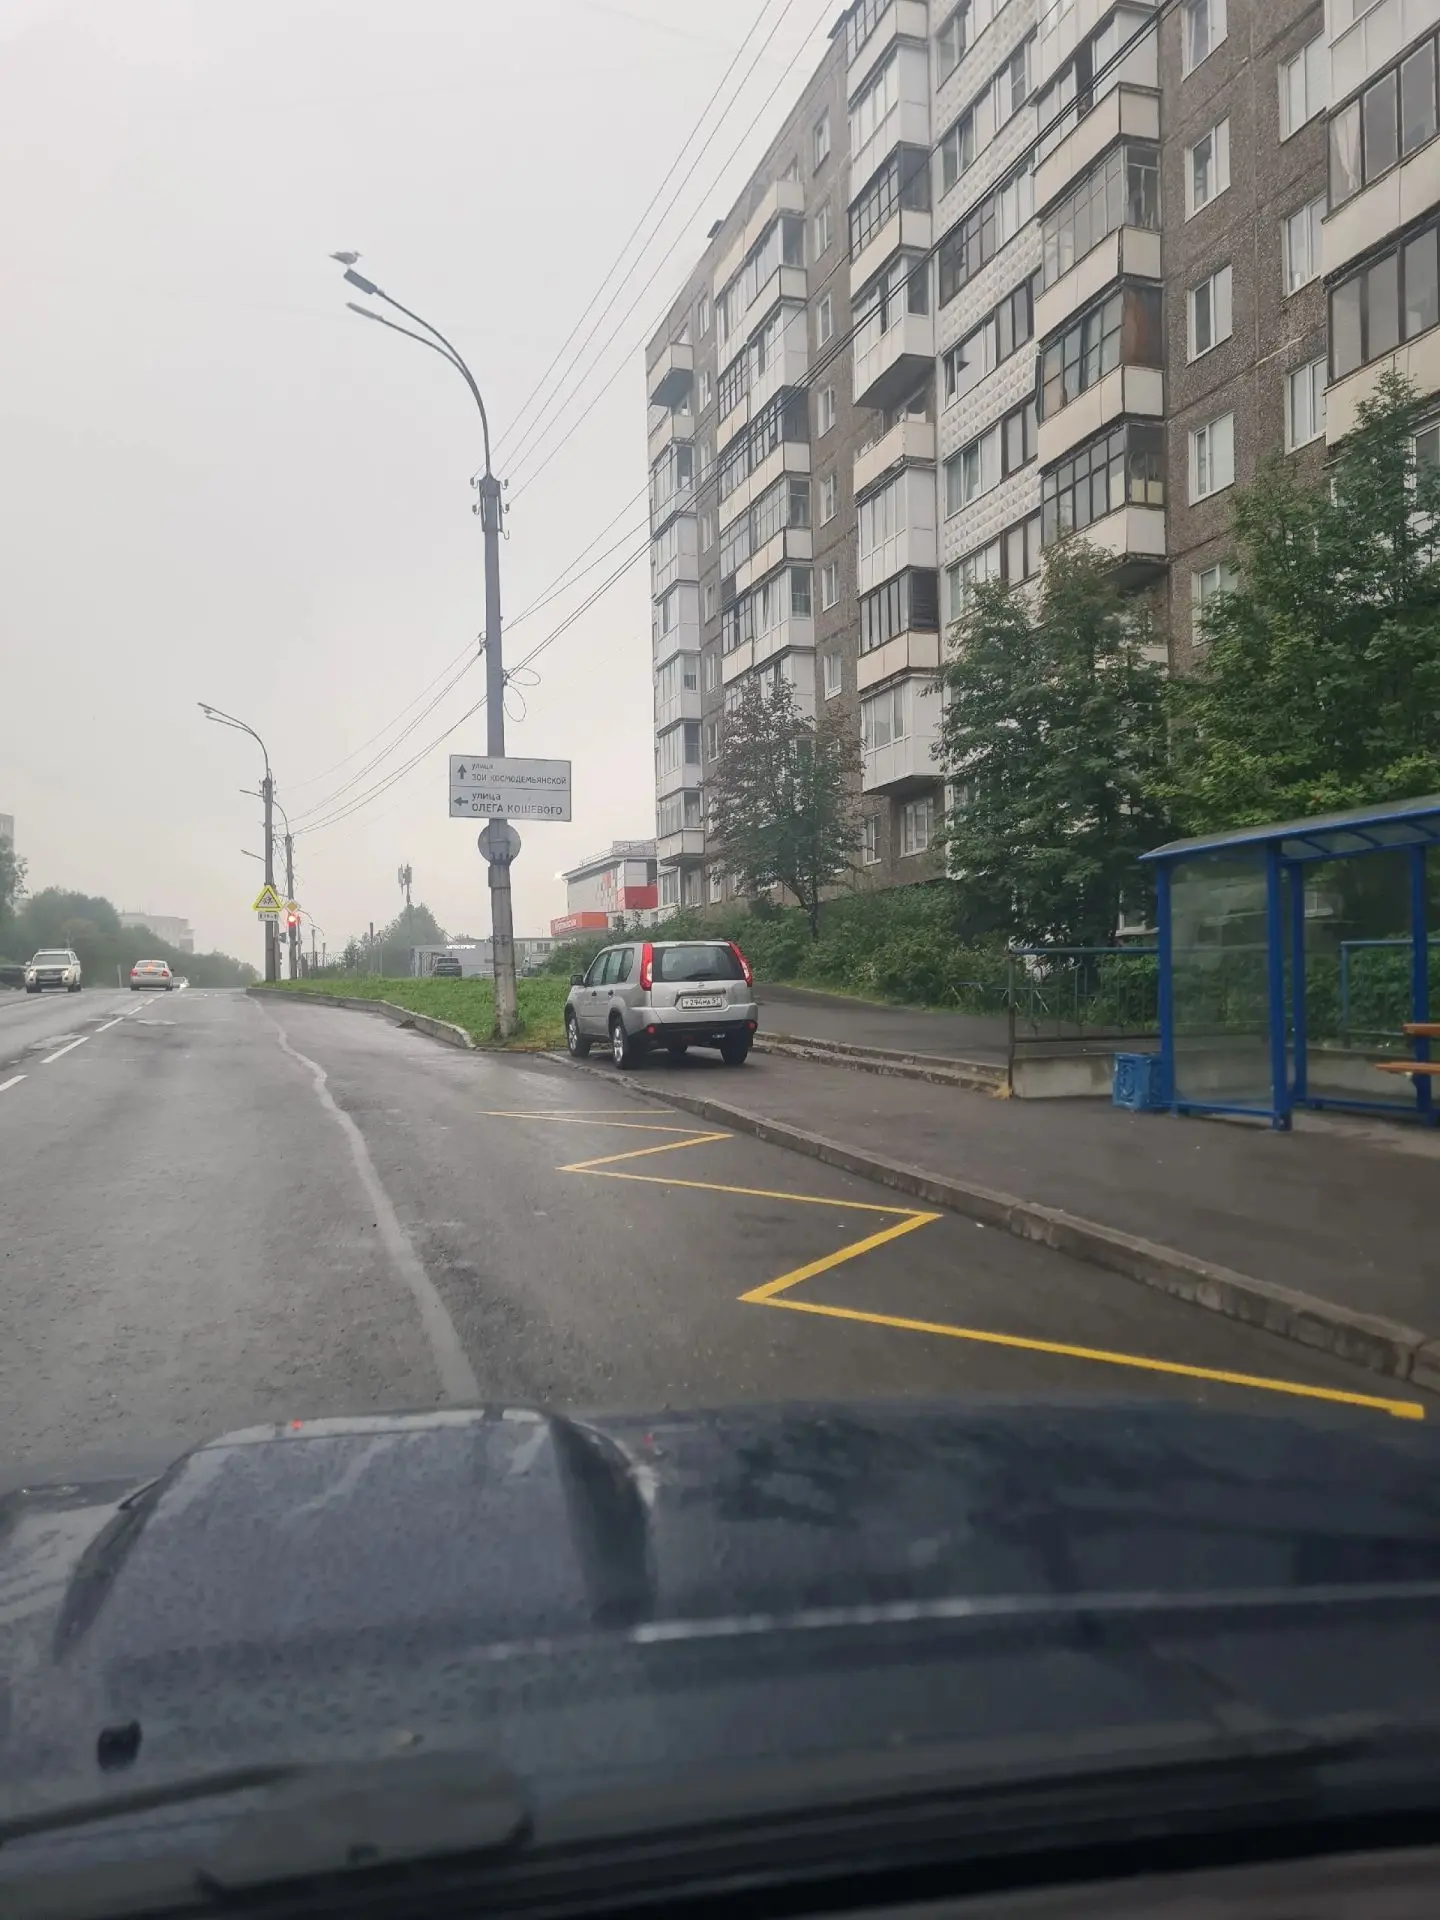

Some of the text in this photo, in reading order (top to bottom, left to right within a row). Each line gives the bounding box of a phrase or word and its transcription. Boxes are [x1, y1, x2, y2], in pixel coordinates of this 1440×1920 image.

[471, 763, 494, 771] улица
[471, 773, 487, 781] ЗОИ
[471, 792, 501, 802] улица
[471, 803, 563, 815] ОЛЕГА КОШЕВОГО
